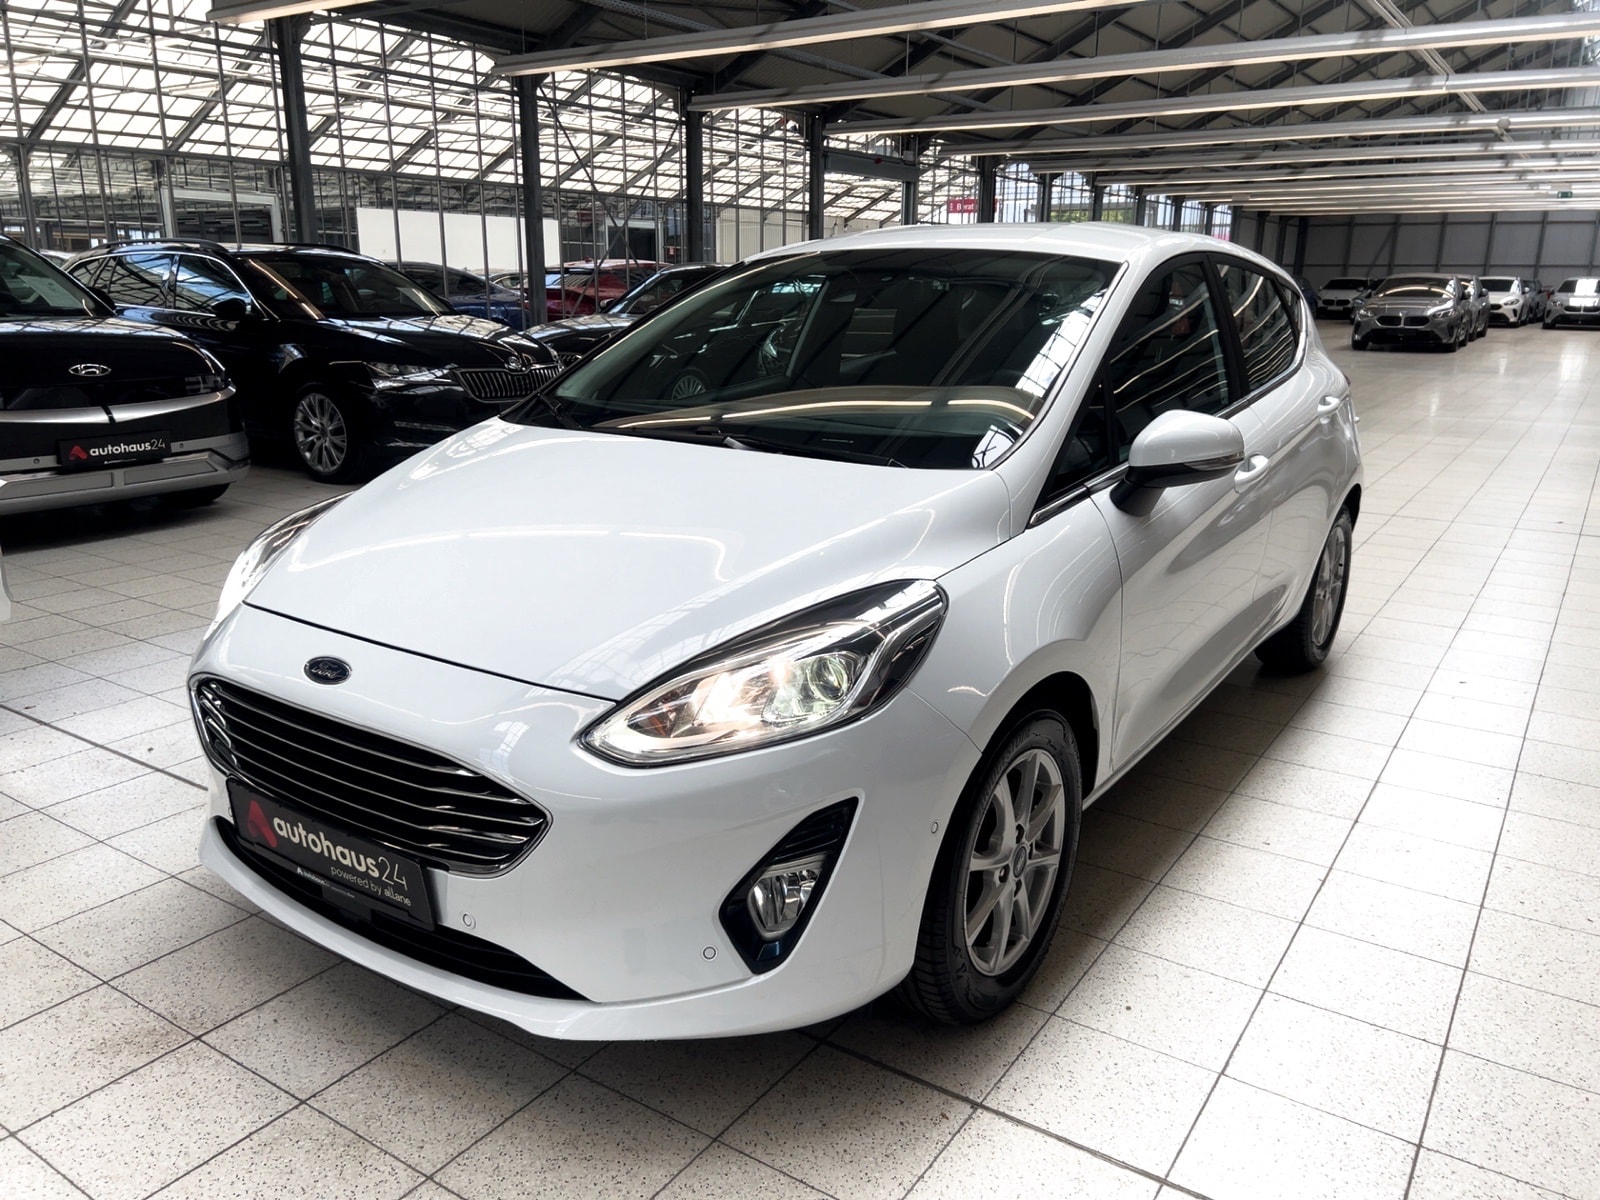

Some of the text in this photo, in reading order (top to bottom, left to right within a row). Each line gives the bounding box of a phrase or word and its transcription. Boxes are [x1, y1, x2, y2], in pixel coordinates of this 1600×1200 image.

[89, 438, 166, 456] autohaus24
[273, 816, 408, 890] autohaus24
[330, 865, 369, 888] powered
[369, 880, 382, 896] by
[383, 886, 412, 907] allane
